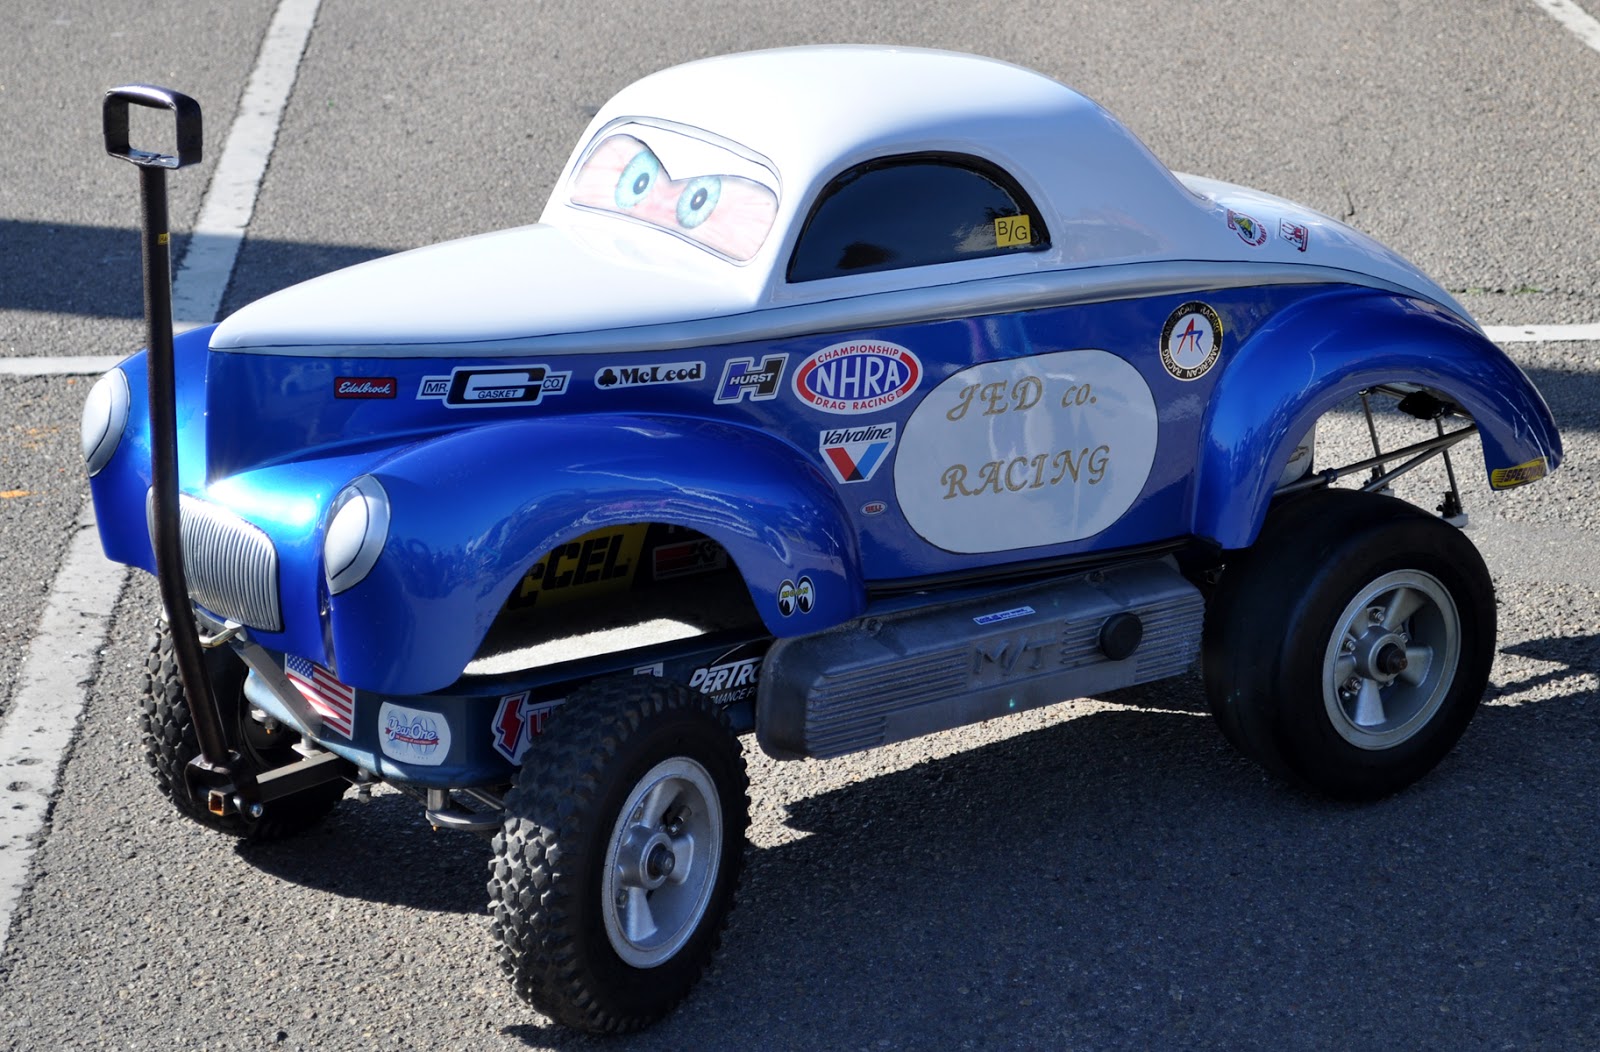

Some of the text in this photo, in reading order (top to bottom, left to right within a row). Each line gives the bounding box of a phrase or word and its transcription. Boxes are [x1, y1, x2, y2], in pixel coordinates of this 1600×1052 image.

[998, 220, 1027, 242] B/G
[1162, 304, 1220, 378] AMERICAN RACING AMERICAN RACING
[817, 345, 900, 363] CHAMPIONSHIP
[618, 364, 702, 385] McLeod
[729, 372, 775, 386] HURST
[816, 356, 901, 398] NHRA
[338, 381, 392, 396] Edelbrock
[426, 377, 561, 400] MR. GASKET CO.
[945, 375, 1043, 423] JED
[815, 394, 896, 411] DRAG RACING
[822, 425, 893, 446] Valvoline
[940, 444, 1111, 500] RACING
[865, 504, 883, 514] BELL
[507, 534, 629, 611] CCEL
[781, 586, 809, 599] MOON
